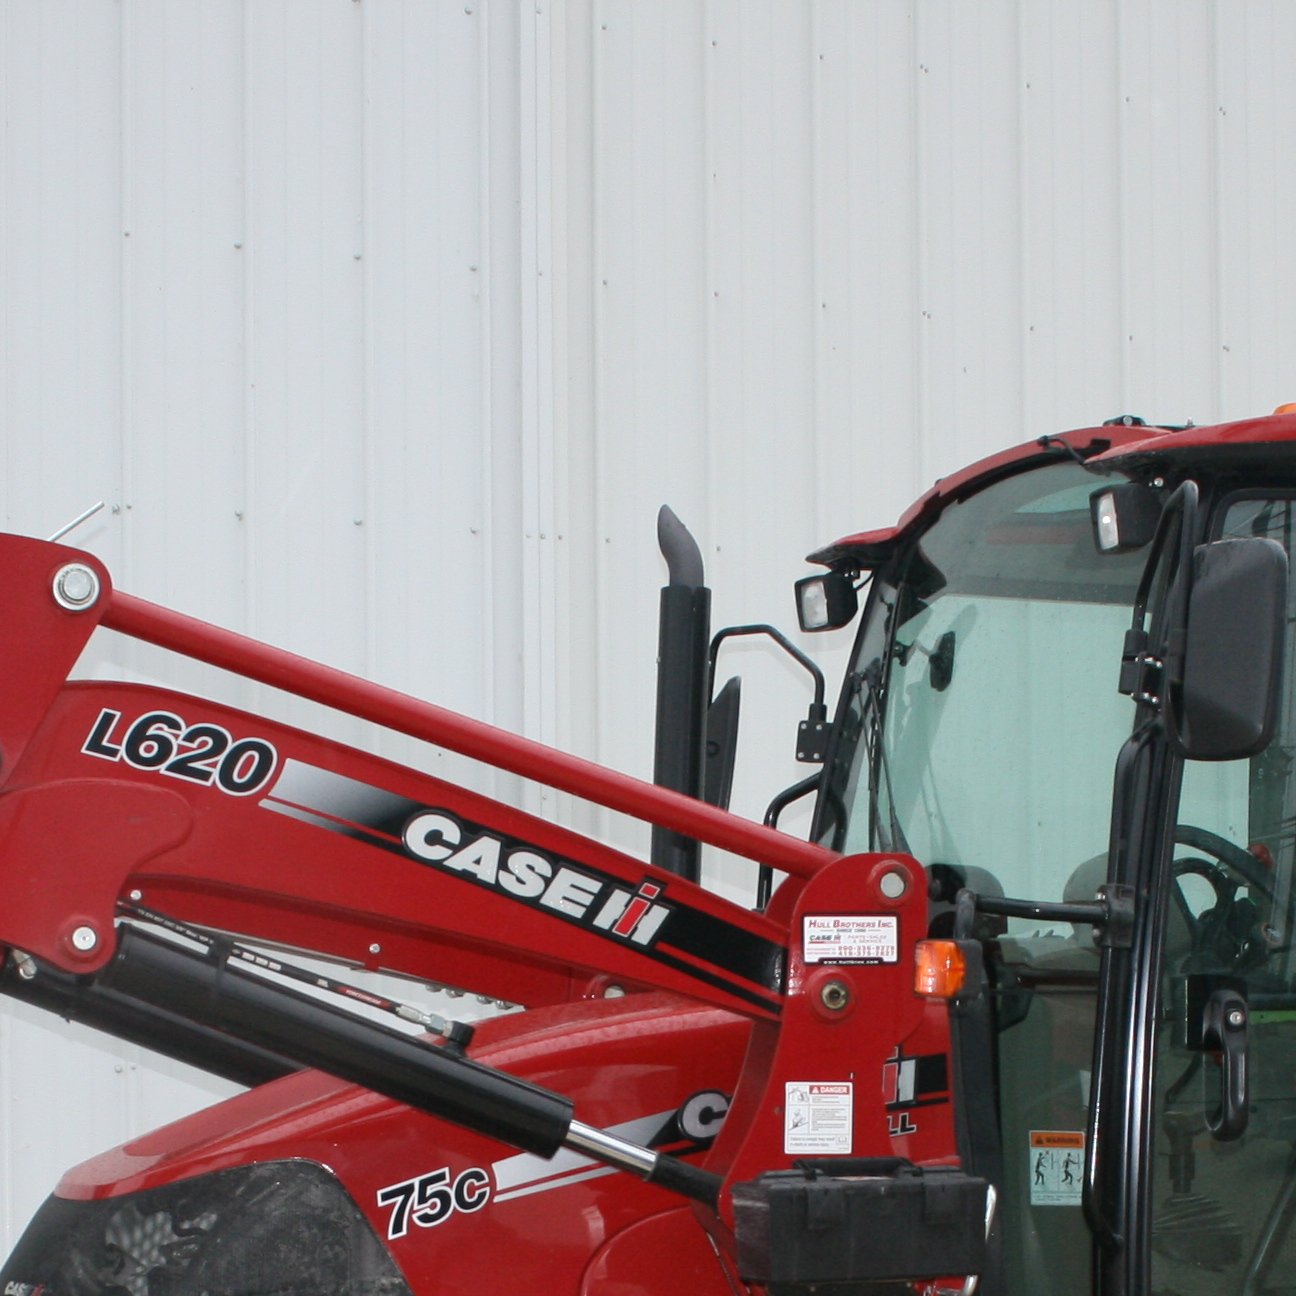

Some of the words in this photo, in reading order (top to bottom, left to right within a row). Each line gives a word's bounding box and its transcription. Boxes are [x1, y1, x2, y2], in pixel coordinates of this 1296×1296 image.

[80, 707, 278, 797] L620
[405, 813, 604, 919] CASE
[820, 1086, 848, 1094] DANGER
[376, 1166, 491, 1241] 75C
